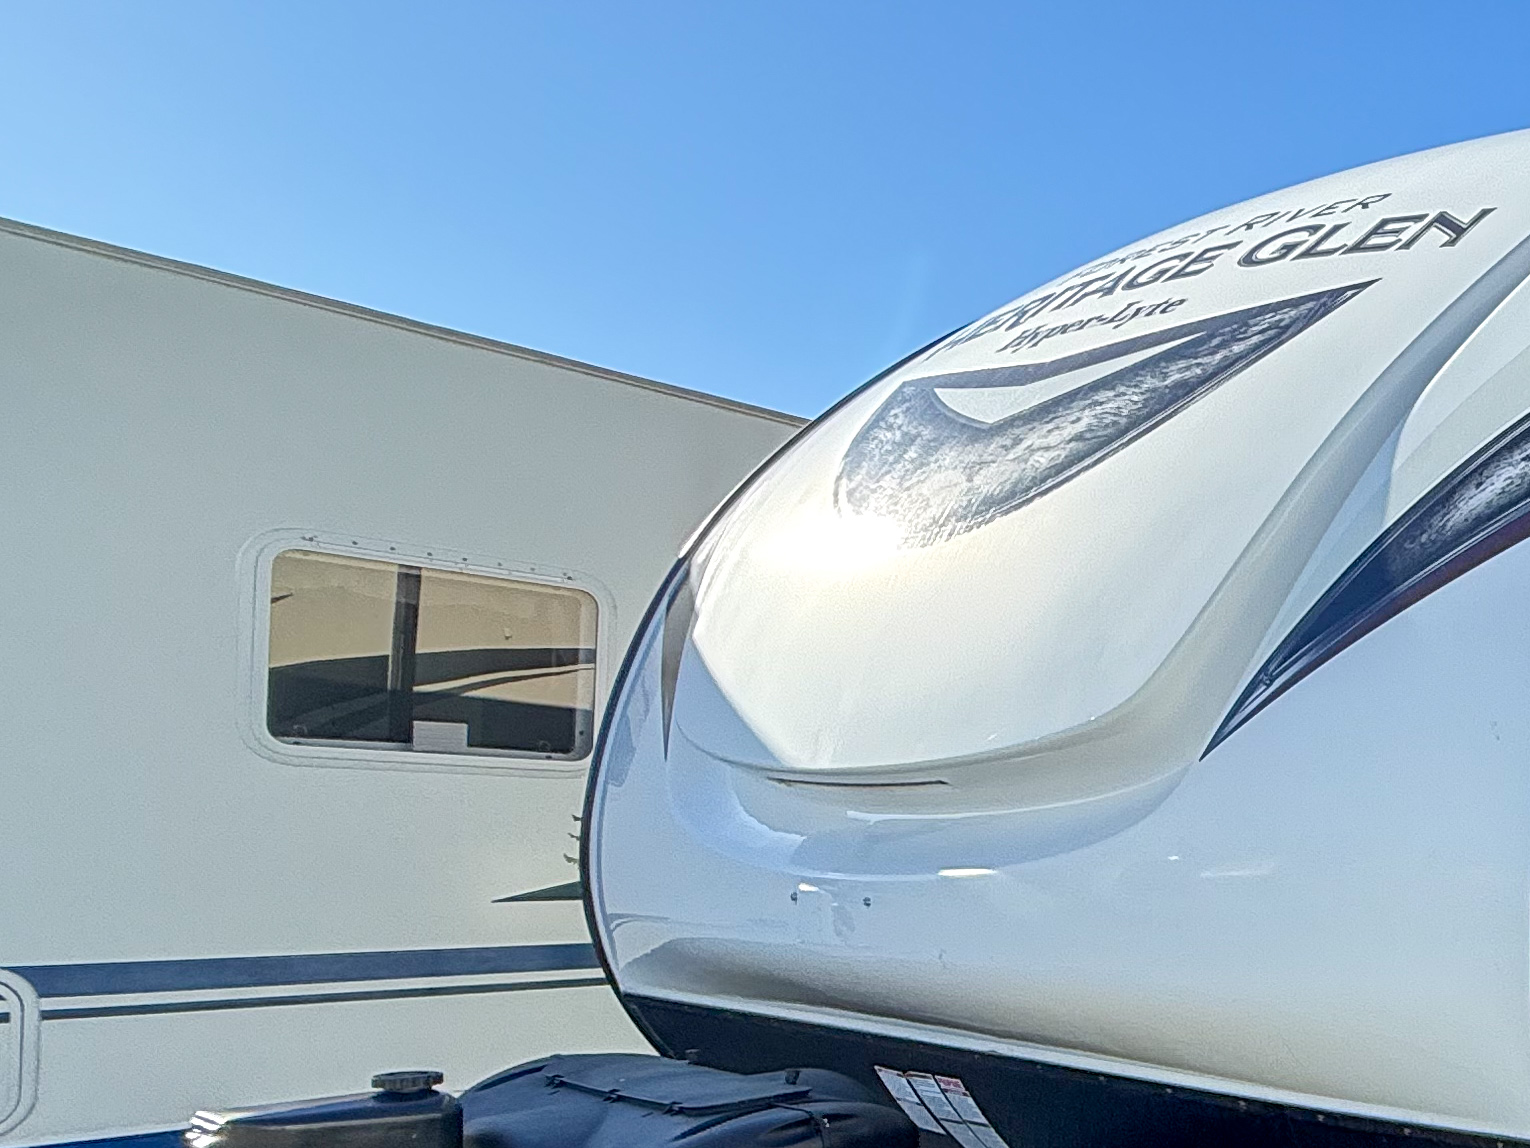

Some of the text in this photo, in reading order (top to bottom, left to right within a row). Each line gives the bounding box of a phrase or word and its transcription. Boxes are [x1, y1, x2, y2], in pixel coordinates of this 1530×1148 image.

[1225, 192, 1393, 236] RIVER
[921, 206, 1498, 364] HERITAGE GLEN
[995, 297, 1189, 355] Hyper-Lyte
